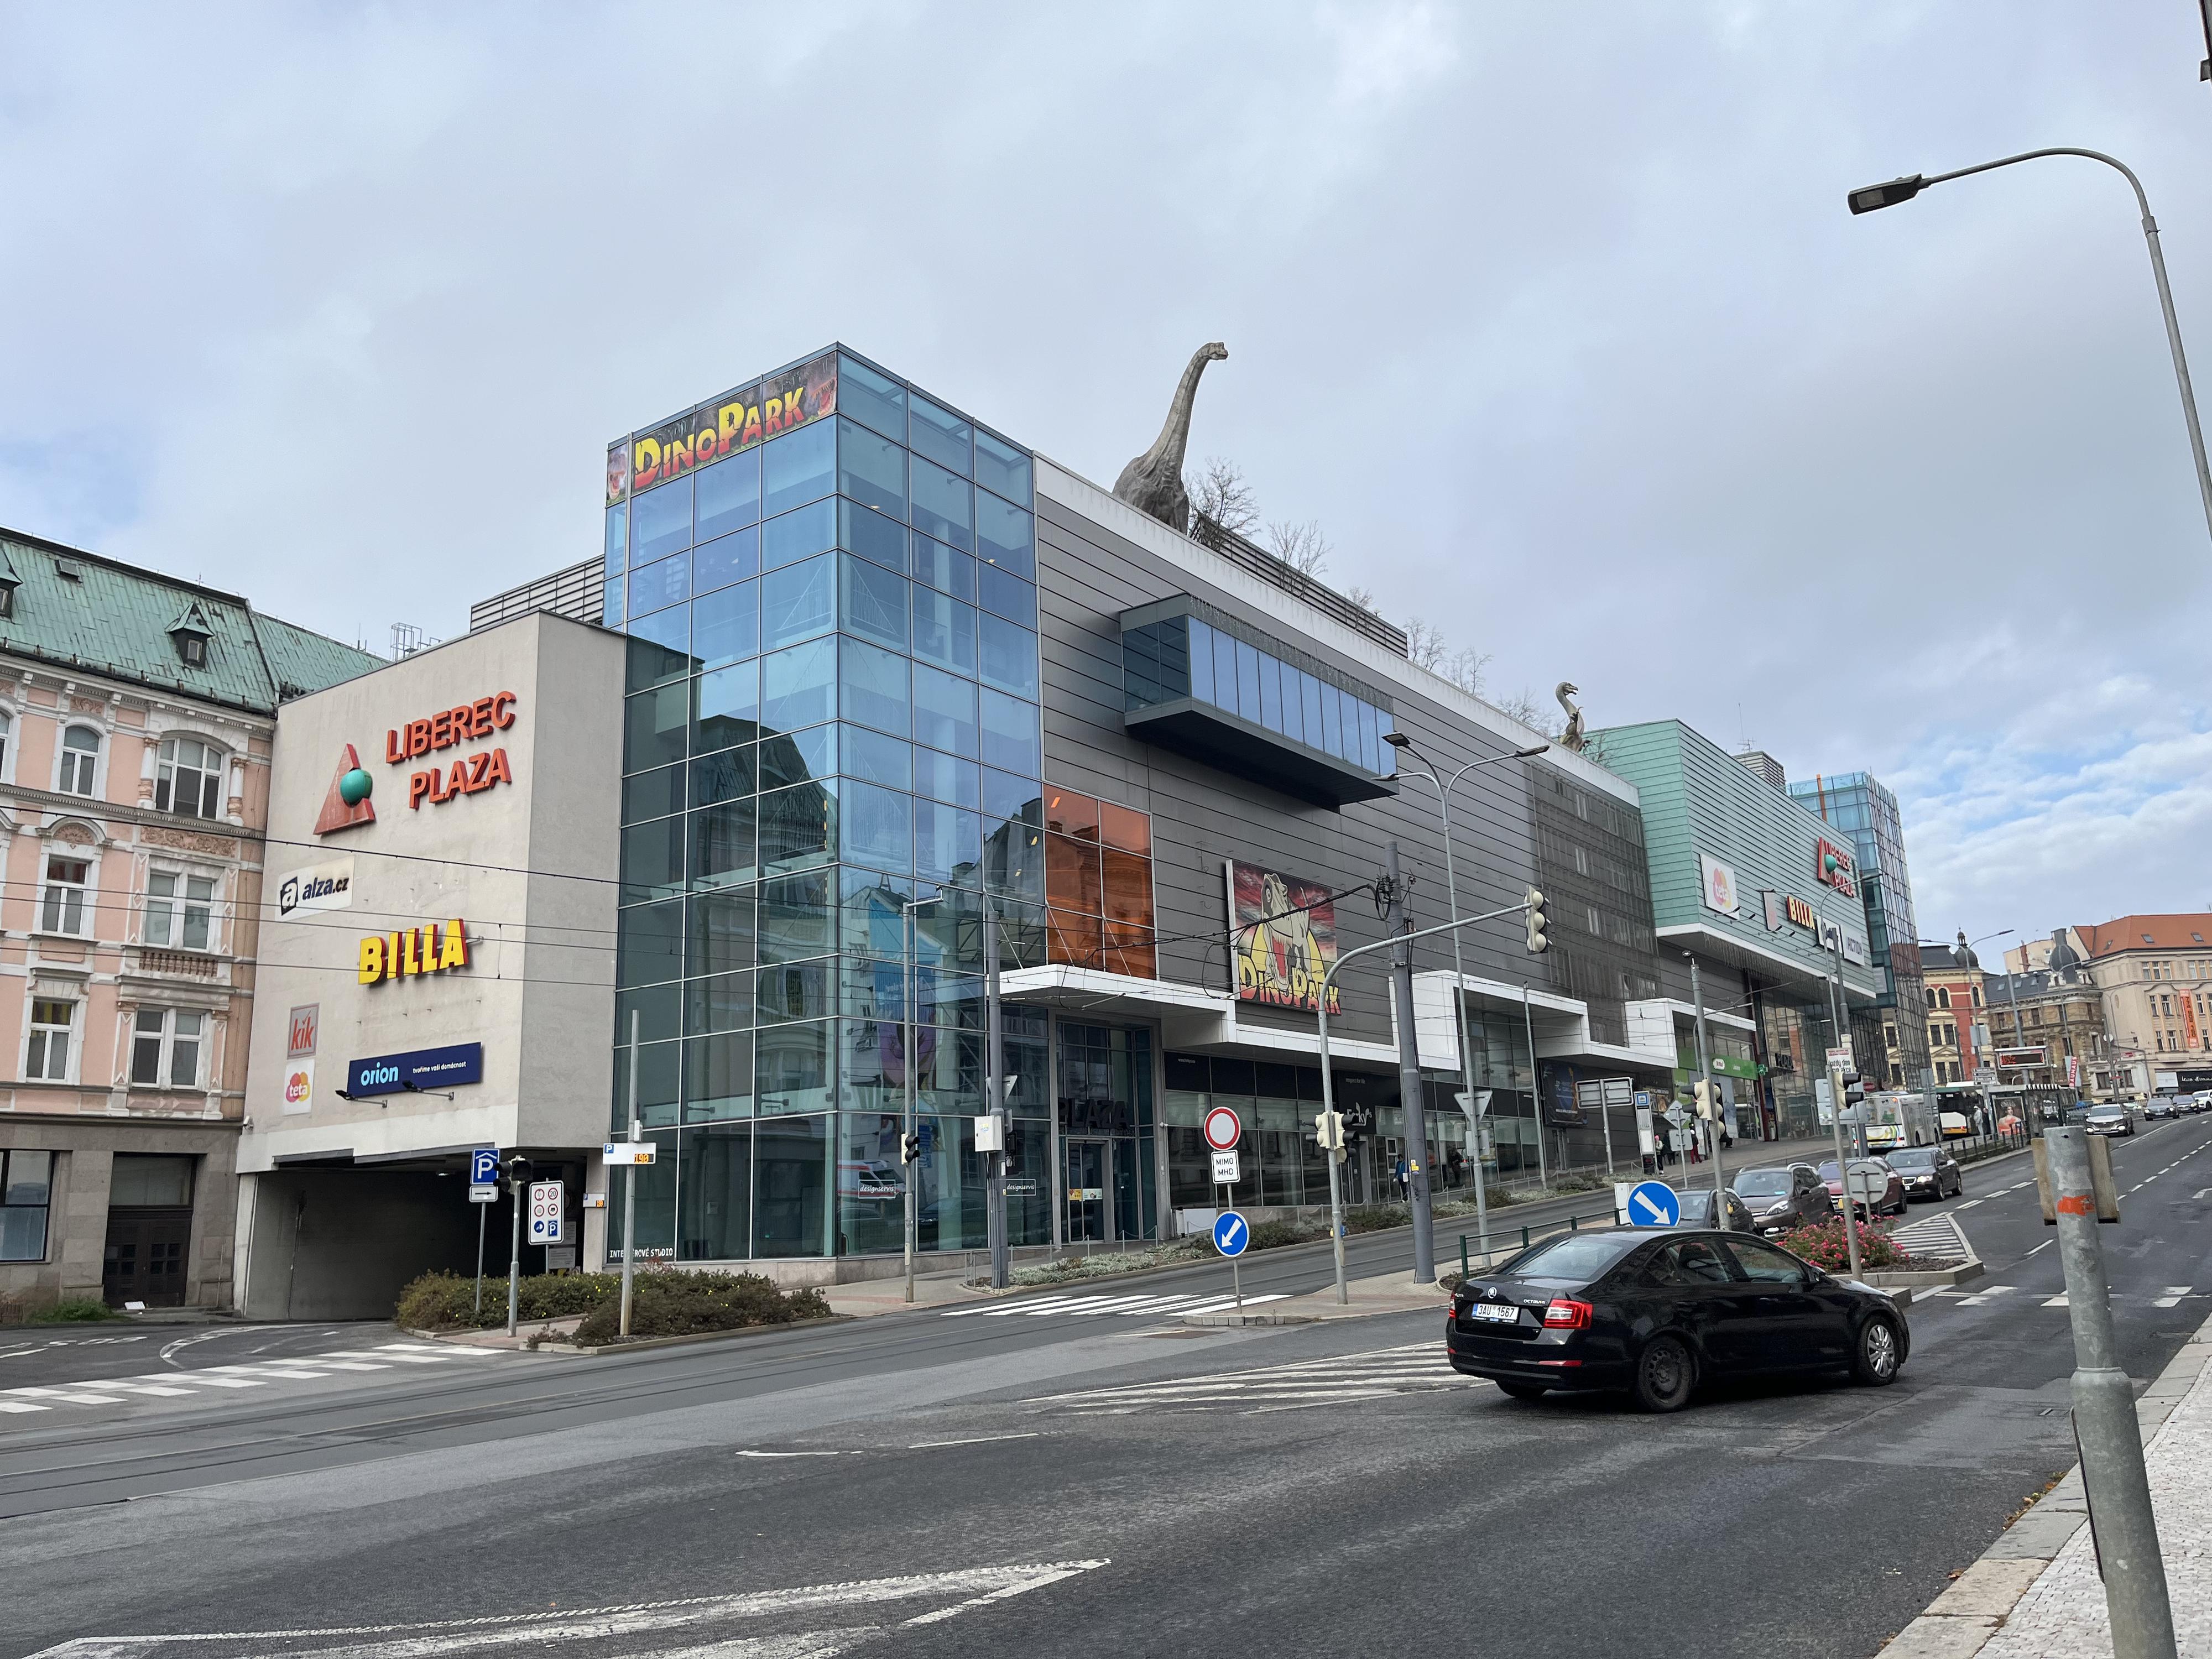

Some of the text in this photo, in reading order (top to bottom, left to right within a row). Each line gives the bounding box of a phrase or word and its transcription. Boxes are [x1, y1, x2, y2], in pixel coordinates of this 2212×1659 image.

[386, 691, 516, 764] LIBEREC
[409, 748, 512, 810] PLAZA
[302, 877, 349, 900] alza.cz
[1787, 896, 1815, 930] BILLA
[358, 918, 469, 985] BILLA
[291, 1011, 315, 1051] kik
[361, 1062, 399, 1086] orion
[2069, 1056, 2077, 1088] BAUHAUS
[289, 1084, 307, 1097] teta
[606, 1145, 613, 1153] P
[635, 1154, 649, 1162] 190
[1216, 1157, 1234, 1166] MIMO
[477, 1158, 494, 1179] P
[1218, 1168, 1233, 1176] MHD
[860, 1185, 894, 1193] designservis
[549, 1224, 556, 1234] P
[609, 1248, 673, 1258] INTEROVÉ STUDIO
[1478, 1306, 1515, 1318] 3AU 1567
